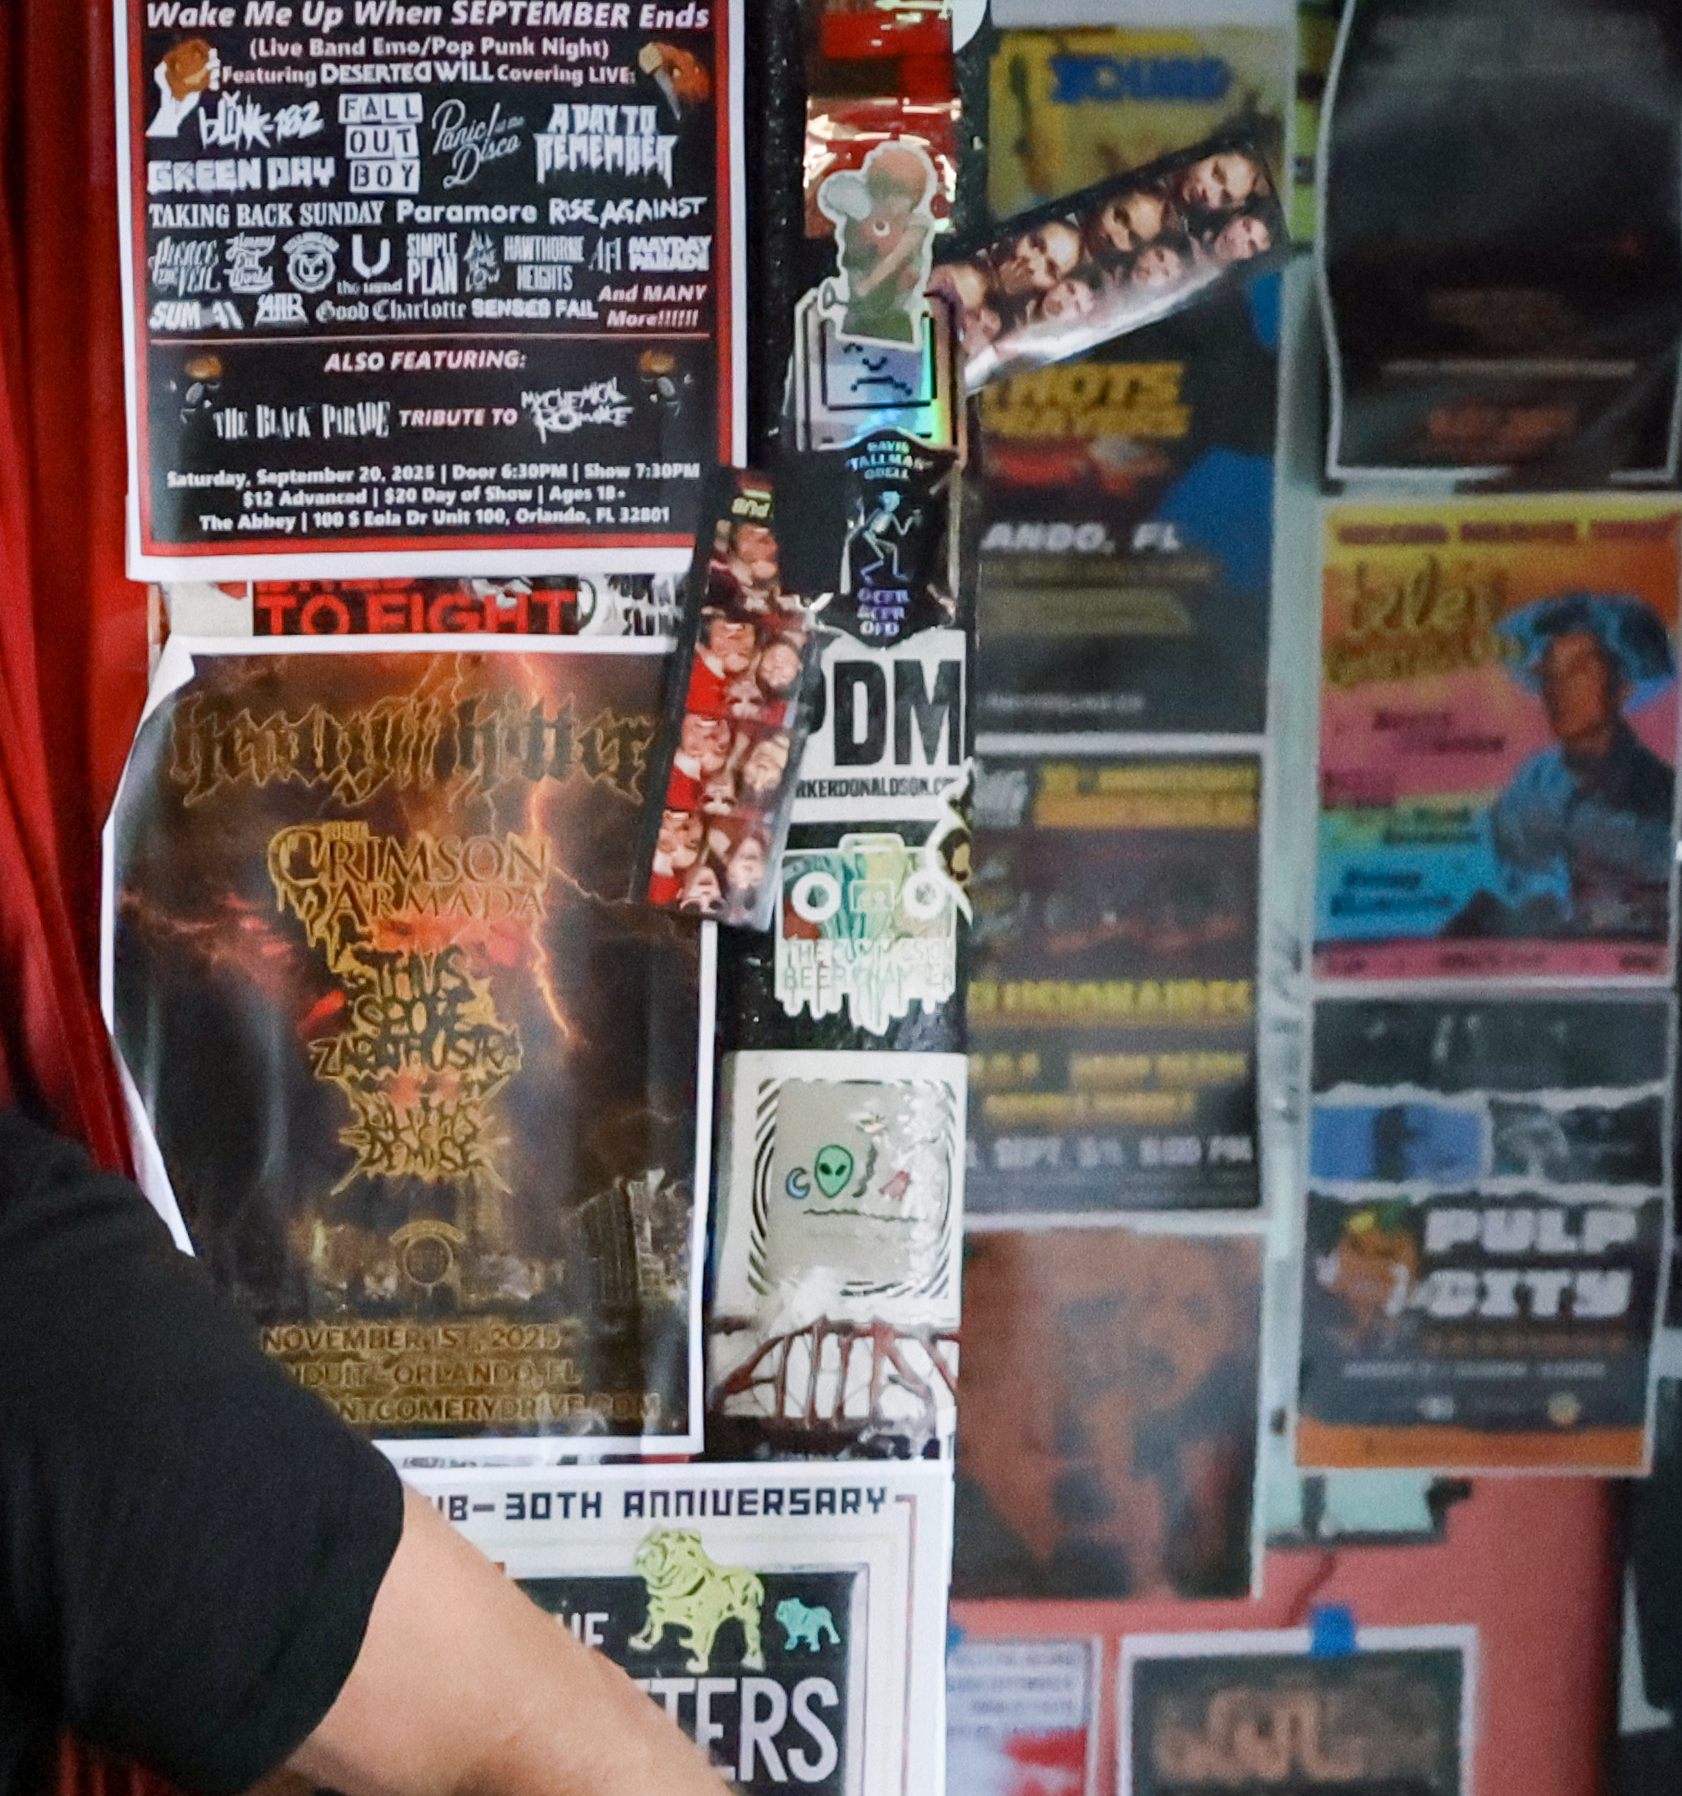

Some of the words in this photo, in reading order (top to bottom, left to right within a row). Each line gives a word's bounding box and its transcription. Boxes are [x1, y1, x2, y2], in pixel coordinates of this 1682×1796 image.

[146, 0, 236, 29] Wake
[243, 0, 293, 27] Me
[301, 0, 345, 34] Up
[354, 0, 443, 26] When
[450, 0, 632, 28] SEPTEMBER
[638, 3, 712, 30] Ends
[249, 37, 303, 60] (Live
[308, 36, 367, 57] Band
[372, 36, 475, 61] Emo/Pop
[479, 36, 536, 58] Punk
[540, 35, 611, 62] Night)
[221, 67, 318, 88] Featuring
[496, 63, 585, 87] Covering
[341, 95, 423, 123] FALL
[347, 126, 415, 156] OUT
[147, 157, 263, 195] GREEN
[265, 156, 337, 191] DAY
[532, 134, 680, 190] REMEMBER
[352, 162, 416, 191] BOY
[148, 203, 232, 229] TAKING
[236, 202, 295, 228] BACK
[297, 201, 387, 227] SUNDAY
[395, 199, 538, 224] Paramore
[548, 196, 600, 226] RISE
[599, 196, 709, 230] AGAINST
[598, 284, 639, 303] And
[643, 283, 708, 302] MANY
[371, 297, 468, 322] Charlotte
[324, 351, 386, 373] ALSO
[390, 349, 528, 372] FEATURING:
[398, 407, 485, 428] TRIBUTE
[255, 466, 356, 489] September
[451, 463, 497, 481] Door
[500, 462, 569, 480] 6:30PM
[584, 462, 631, 480] Show
[635, 461, 702, 480] 7:30PM
[278, 488, 369, 508] Advanced
[484, 485, 534, 502] Show
[237, 513, 298, 534] Abbey
[255, 594, 351, 636] TO
[267, 824, 551, 888] CRIMSON
[1425, 1207, 1638, 1254] PULP
[260, 1327, 418, 1351] NOVEMBER
[624, 1486, 888, 1518] ANNIVERSARY
